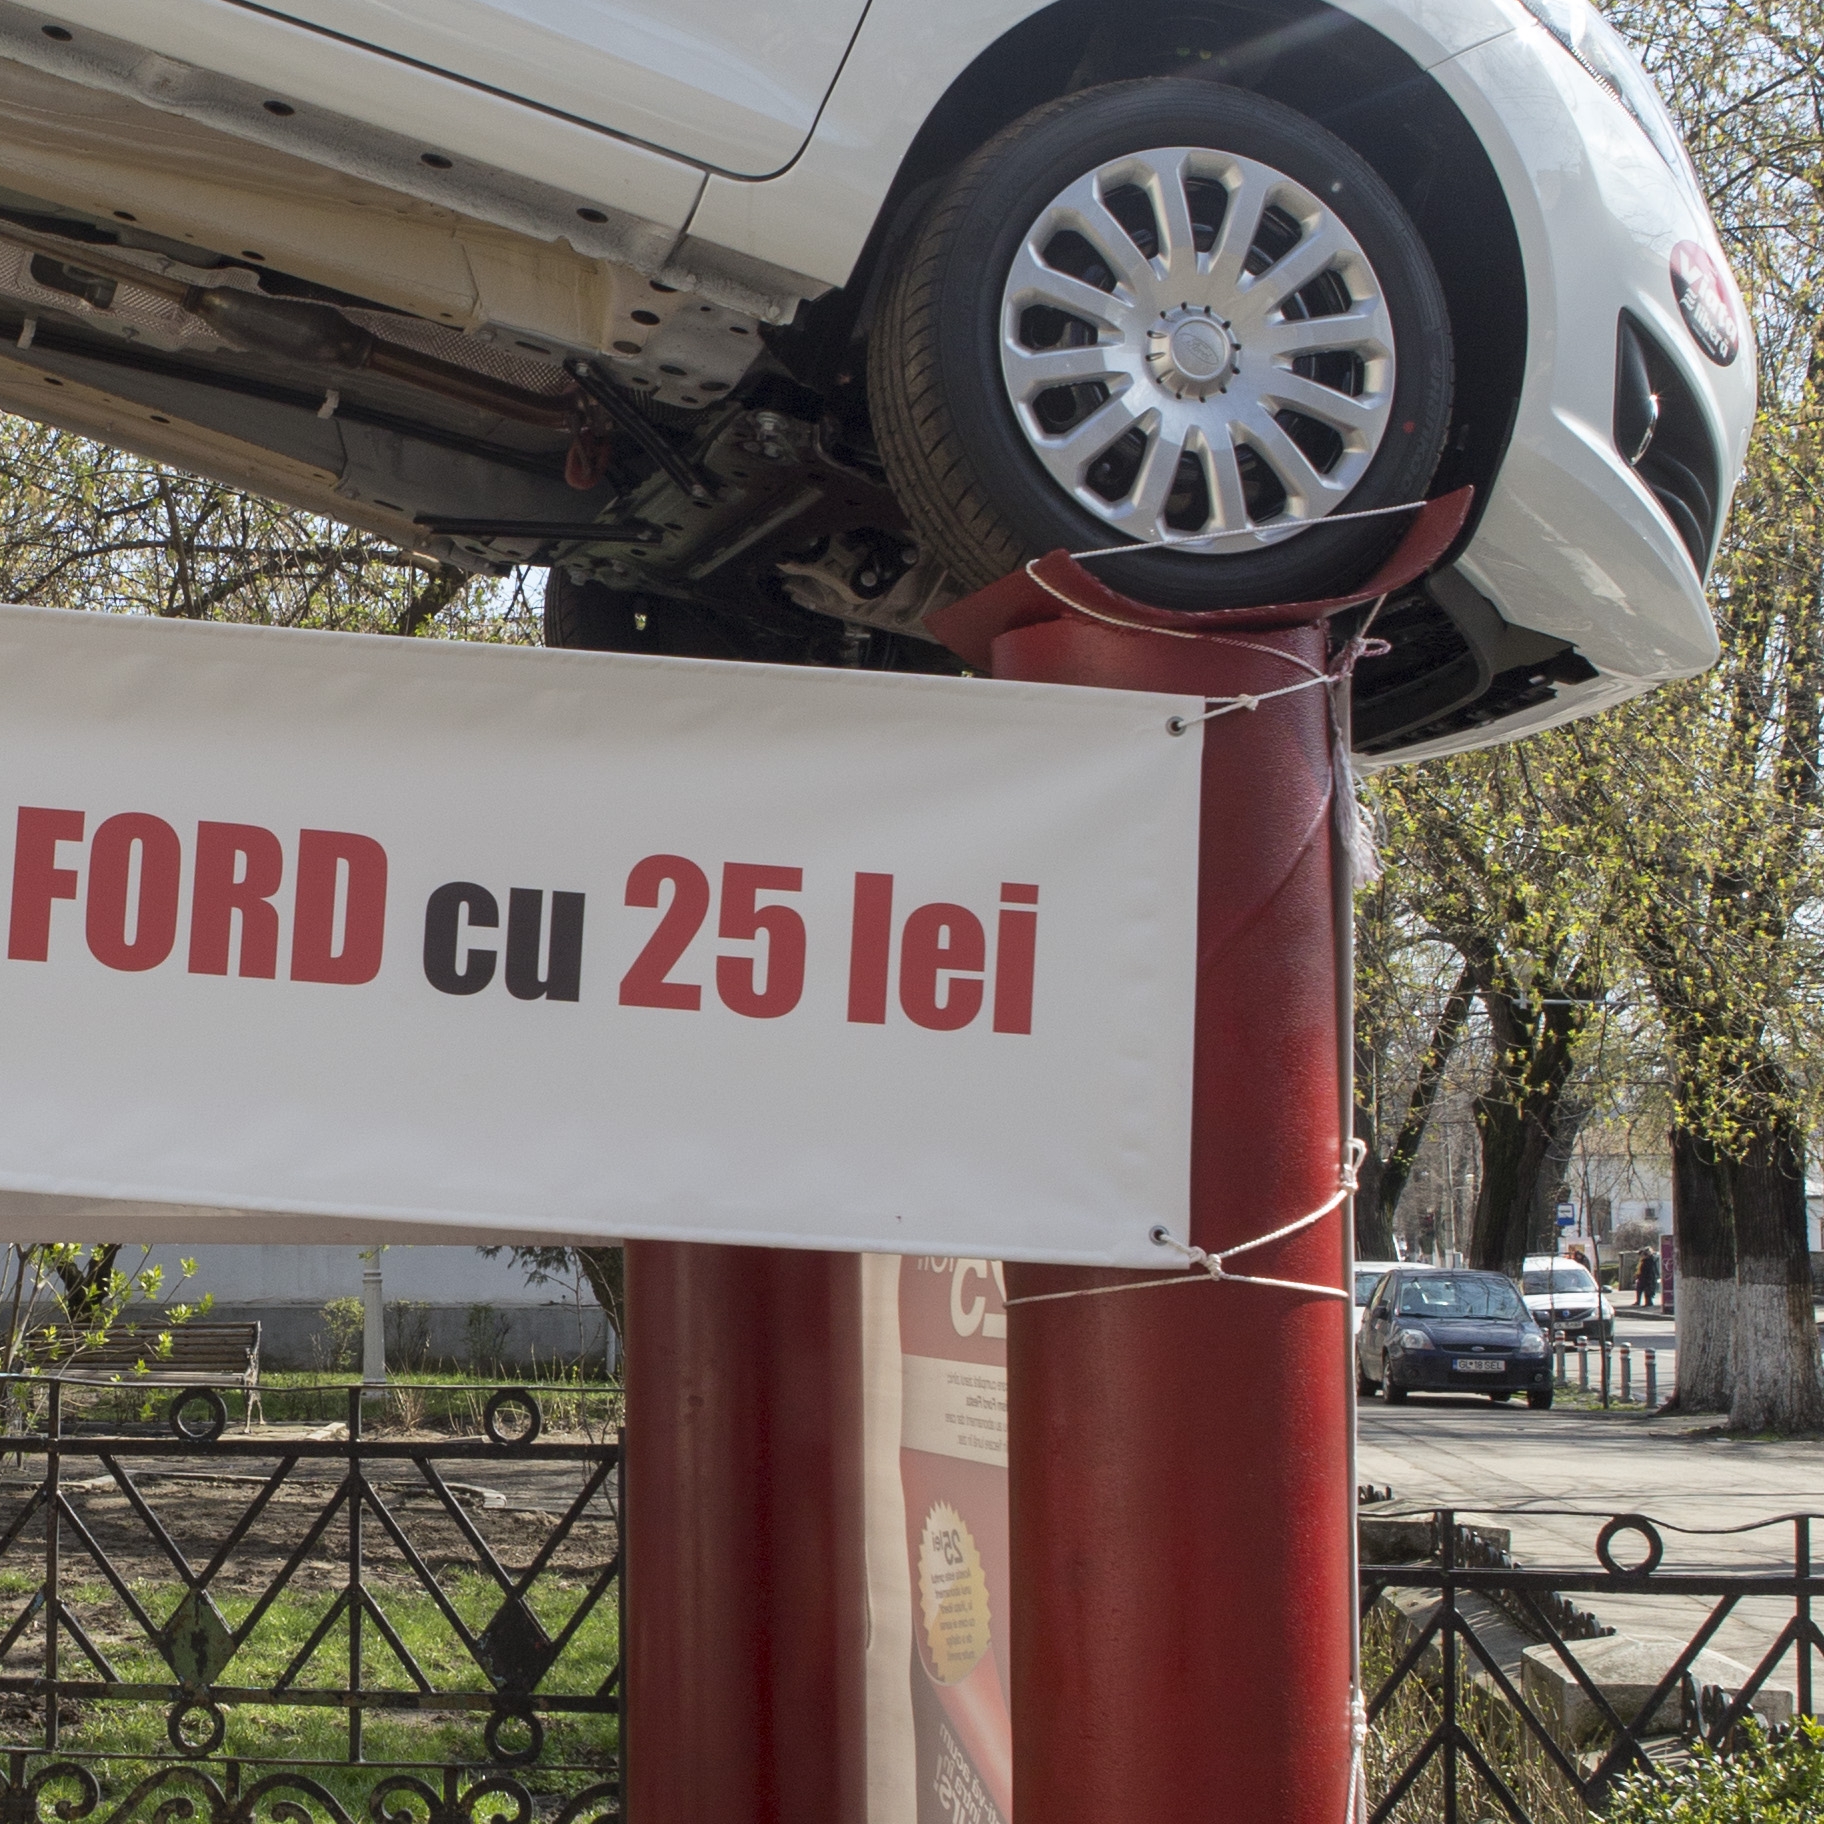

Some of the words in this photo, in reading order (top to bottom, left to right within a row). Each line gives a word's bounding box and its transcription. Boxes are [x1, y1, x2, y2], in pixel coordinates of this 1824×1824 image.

[7, 806, 389, 986] FORD
[422, 881, 587, 1003] cu
[617, 853, 808, 1020] 25
[846, 871, 1041, 1036] lei
